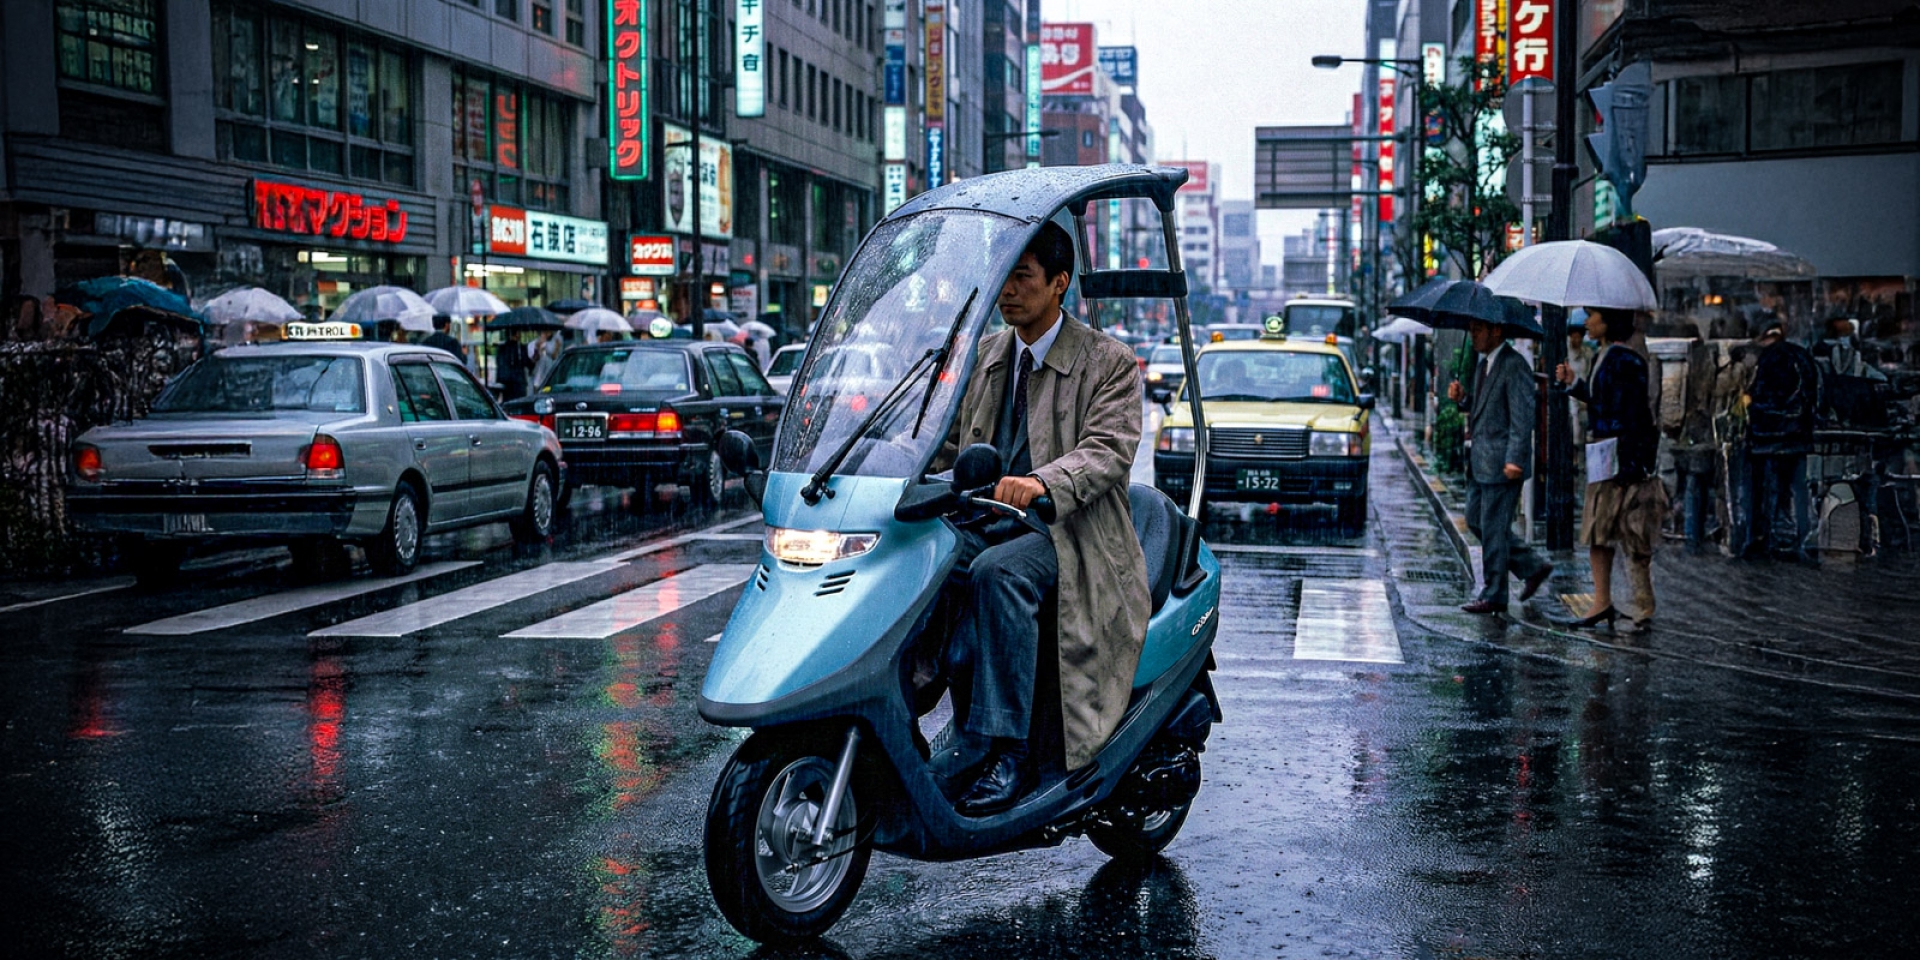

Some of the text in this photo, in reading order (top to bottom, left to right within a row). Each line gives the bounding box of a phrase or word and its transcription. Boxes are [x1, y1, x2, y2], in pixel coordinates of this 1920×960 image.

[615, 0, 641, 167] オクトリック
